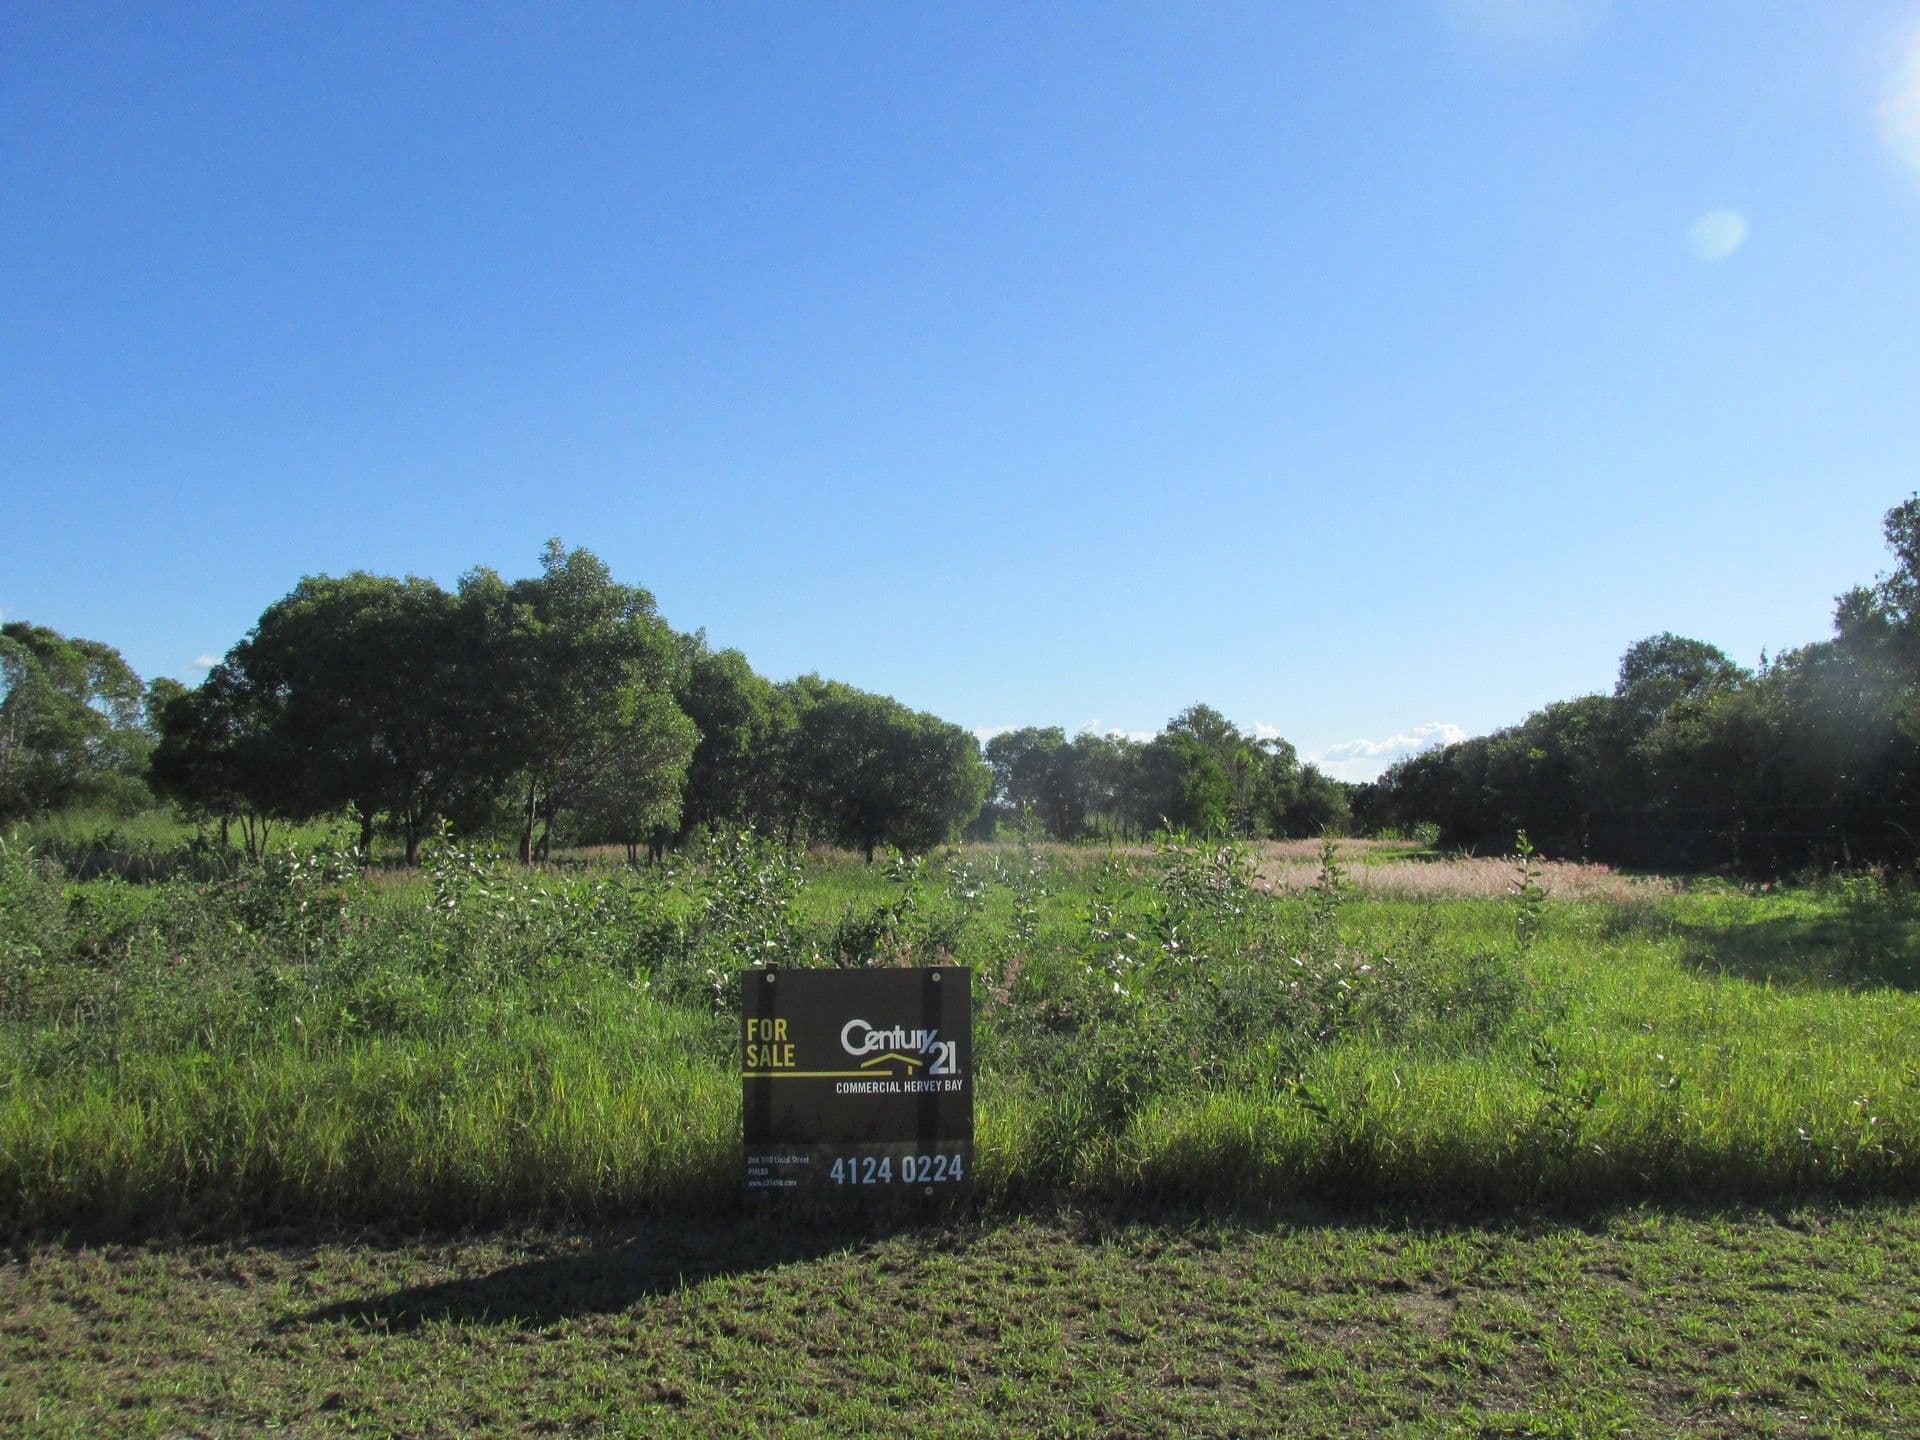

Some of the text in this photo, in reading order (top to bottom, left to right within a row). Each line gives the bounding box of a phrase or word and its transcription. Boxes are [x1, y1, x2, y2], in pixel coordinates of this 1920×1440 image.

[747, 1018, 788, 1041] FOR
[840, 1019, 938, 1056] Century
[746, 1044, 796, 1067] SALE
[928, 1040, 957, 1075] 21
[836, 1079, 963, 1094] COMMERCIAL HERVEY BAY
[830, 1154, 963, 1184] 4124 0224
